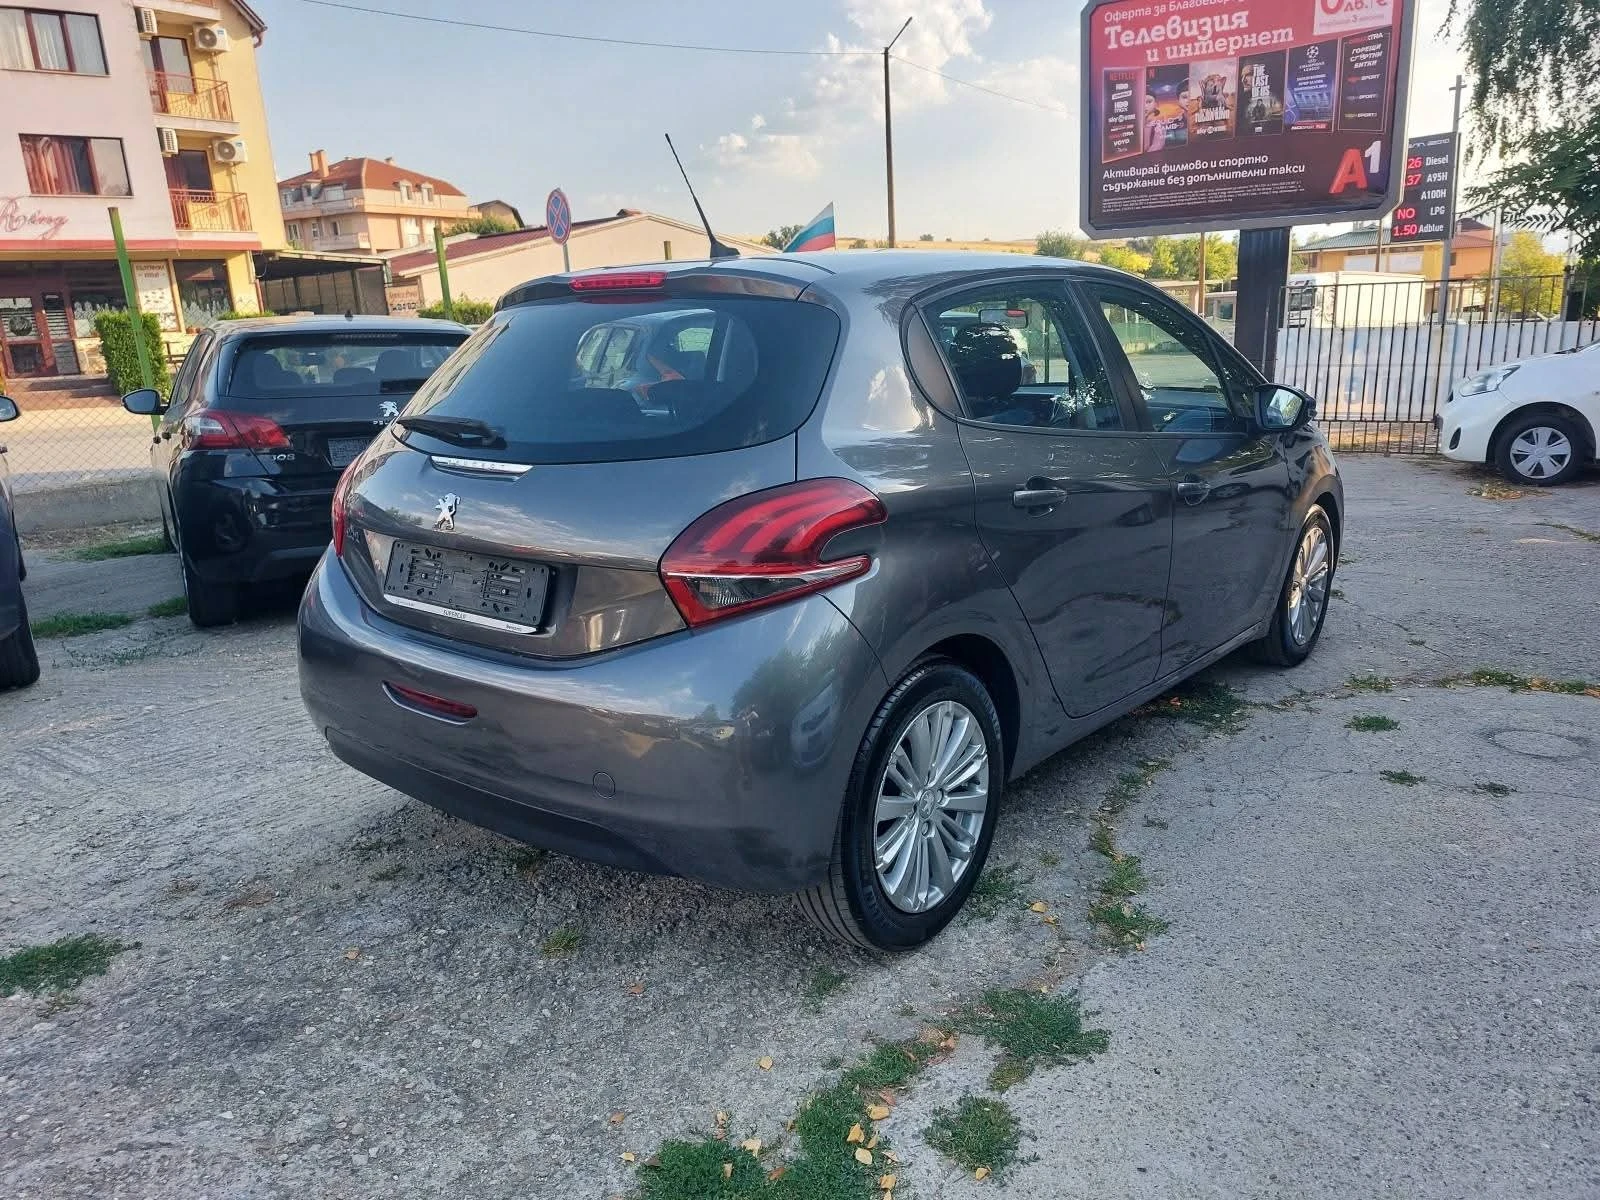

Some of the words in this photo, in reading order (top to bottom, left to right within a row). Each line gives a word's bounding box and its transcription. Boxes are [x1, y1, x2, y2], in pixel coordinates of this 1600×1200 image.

[1104, 6, 1151, 22] Оферта
[1153, 6, 1166, 17] за
[1104, 11, 1249, 49] Телевизия
[1146, 49, 1159, 62] и
[1165, 27, 1294, 60] интернет
[1102, 164, 1160, 180] Активирай
[1161, 159, 1208, 175] филмово
[1210, 159, 1217, 168] и
[1219, 153, 1269, 168] спортно
[1425, 155, 1449, 166] Diesel
[1102, 177, 1165, 193] съдържание
[1167, 175, 1185, 186] без
[1187, 168, 1267, 185] допълнителни
[1268, 163, 1306, 176] такси
[1426, 172, 1448, 183] A95H
[1421, 189, 1447, 200] A100H
[1397, 207, 1415, 219] NO
[1430, 206, 1446, 216] LPG
[1393, 224, 1417, 236] 1.50
[1418, 223, 1444, 234] Adblue
